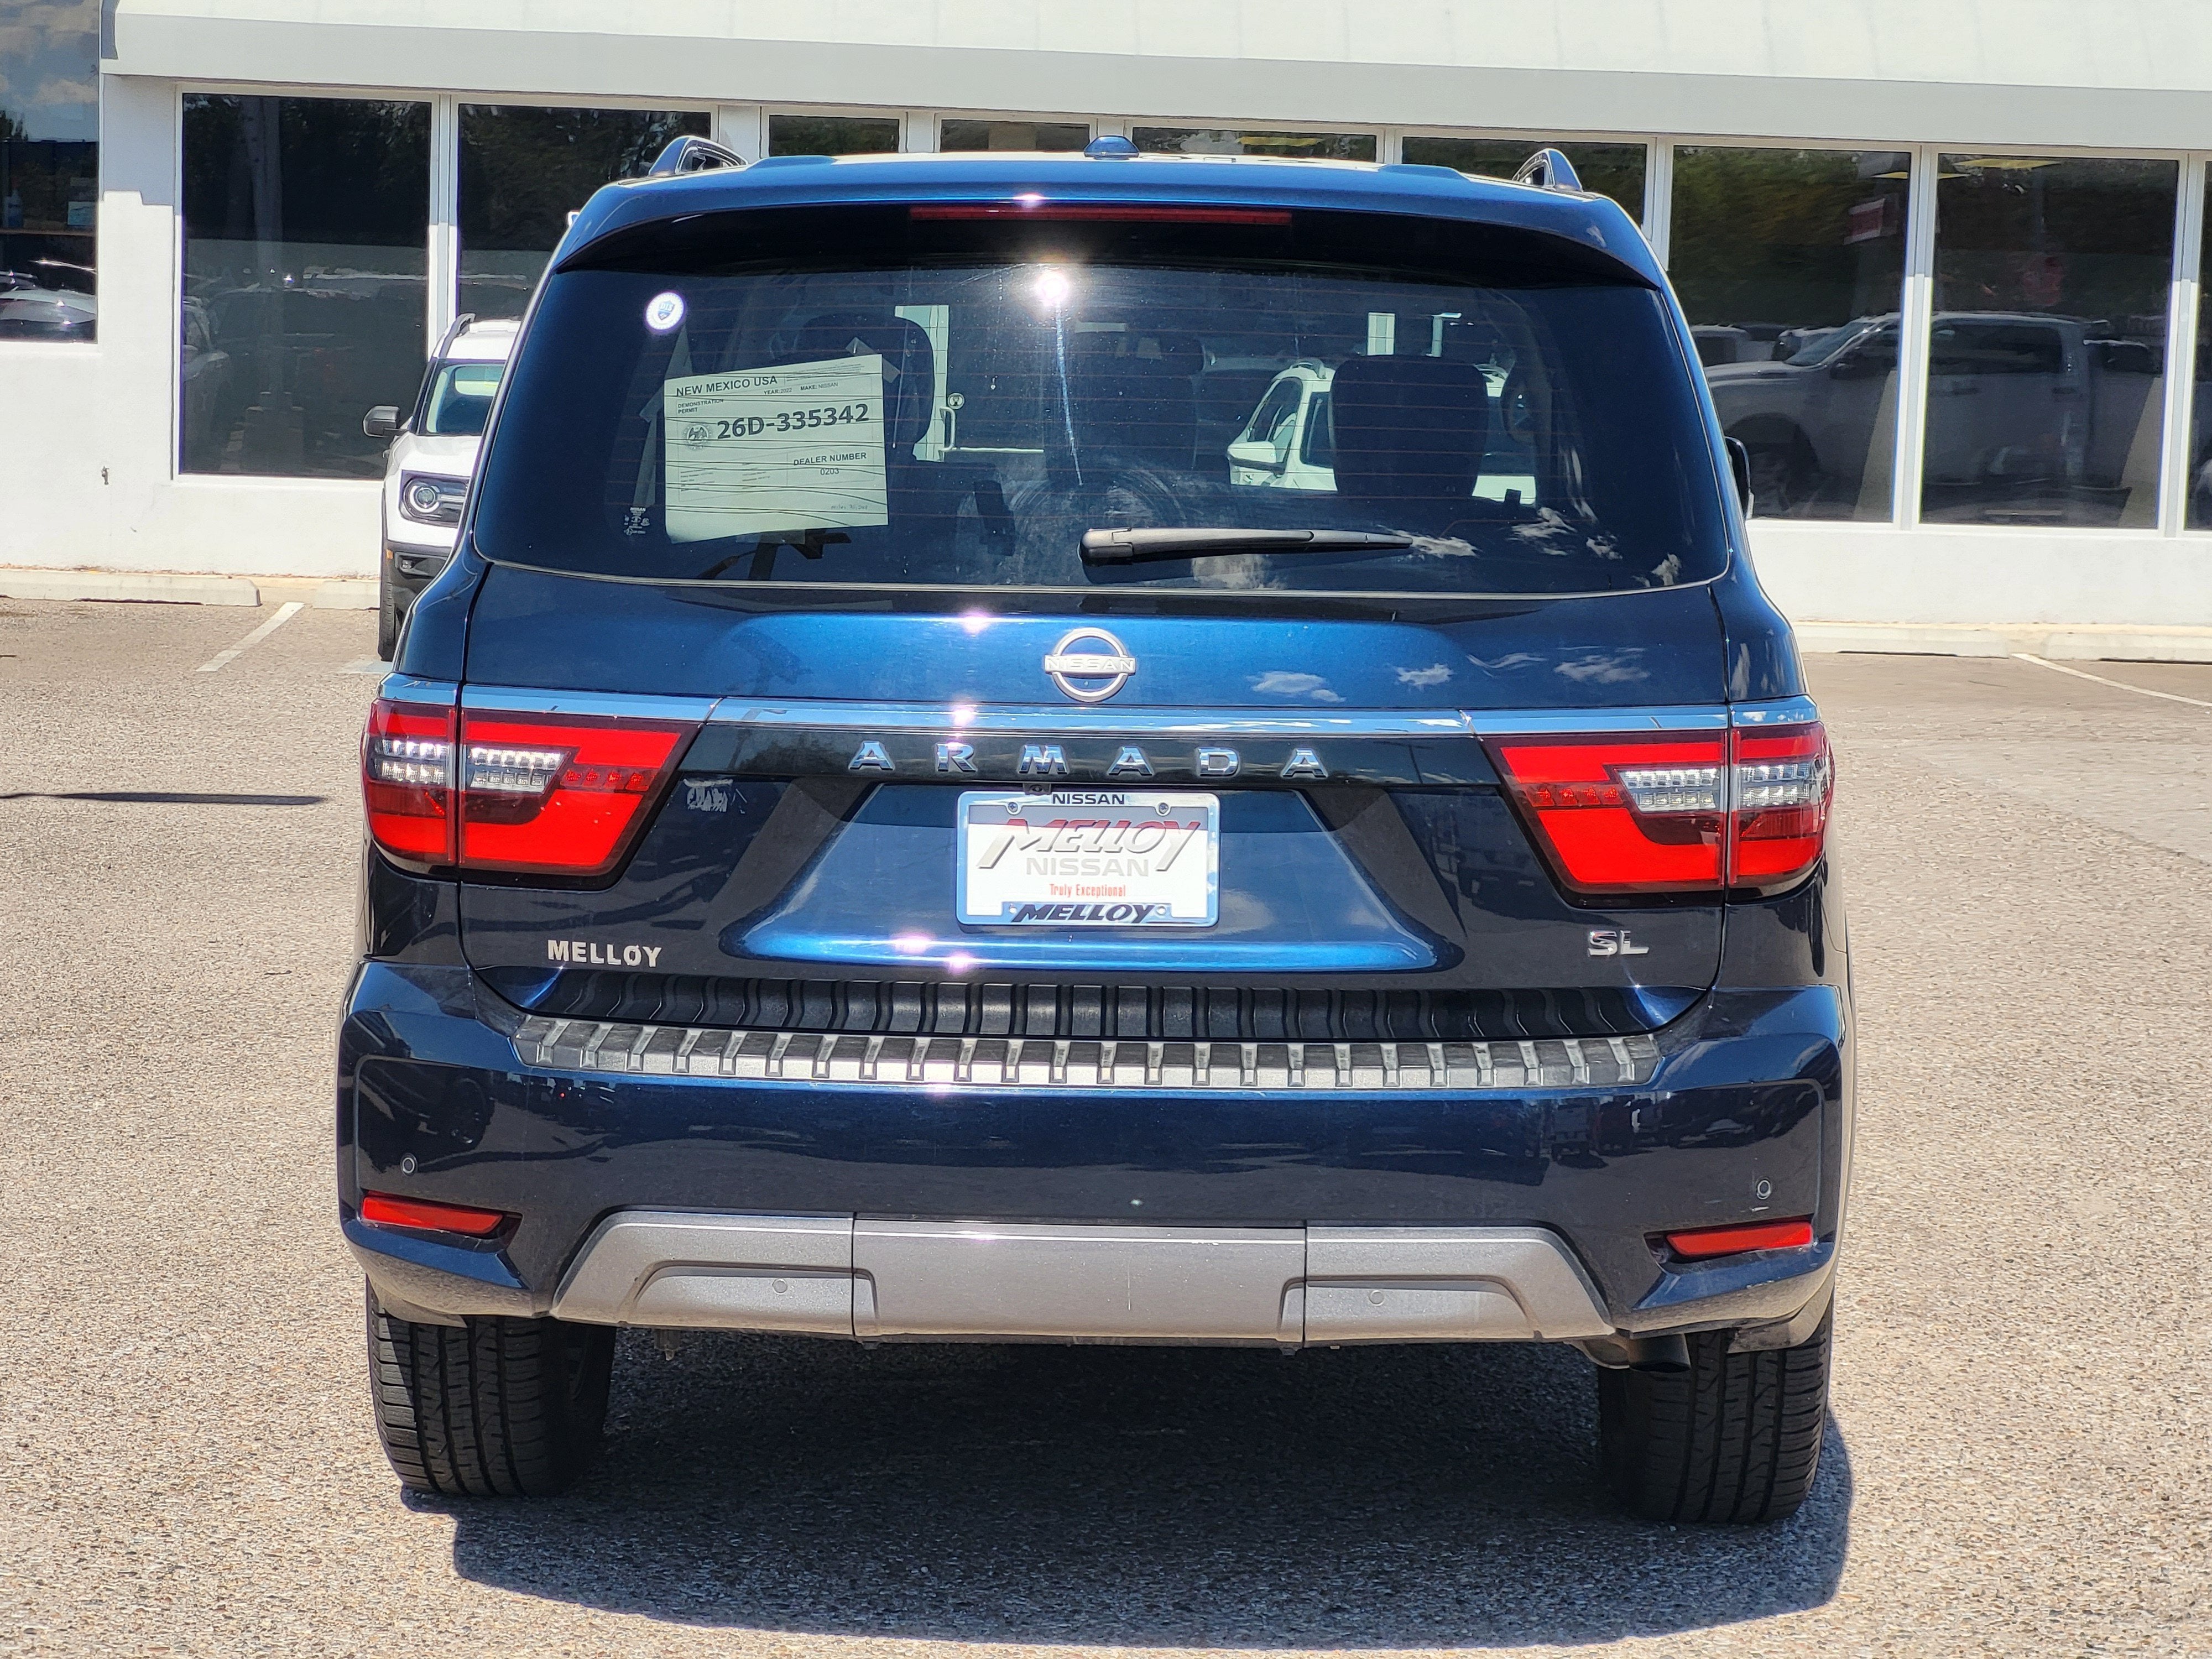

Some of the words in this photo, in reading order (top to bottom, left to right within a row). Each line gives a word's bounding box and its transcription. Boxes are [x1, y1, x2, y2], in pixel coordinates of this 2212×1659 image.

[676, 385, 702, 397] NEW
[706, 379, 750, 393] MEXICO
[754, 375, 778, 387] USA
[678, 399, 724, 408] DEMONSTRATION
[717, 404, 869, 439] 26D-335342
[793, 456, 827, 466] DEALER
[830, 452, 867, 461] NUMBER
[1046, 658, 1134, 671] NISSAN
[848, 740, 1328, 778] ARMADA
[1052, 794, 1125, 805] NISSAN
[975, 818, 1202, 872] MELLOY
[1026, 857, 1149, 877] NISSAN
[1050, 884, 1072, 898] Truly
[1076, 884, 1126, 898] Exceptional
[1010, 903, 1155, 924] MELLOY
[547, 940, 662, 968] MELLOY
[1587, 930, 1650, 957] SL
